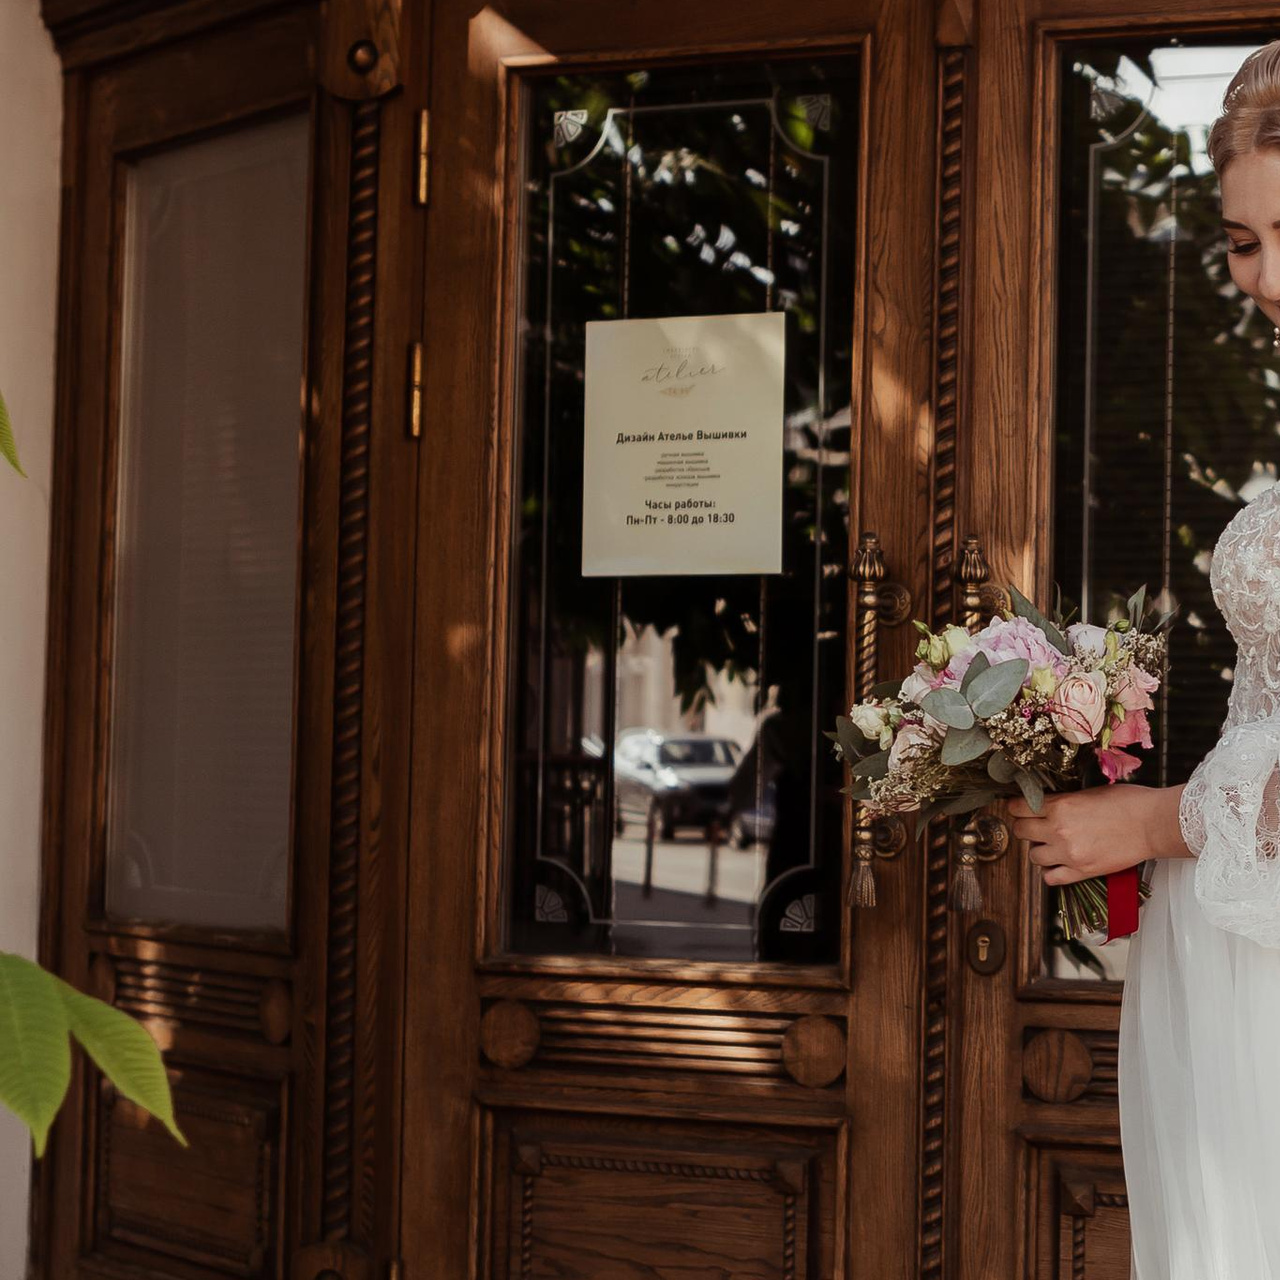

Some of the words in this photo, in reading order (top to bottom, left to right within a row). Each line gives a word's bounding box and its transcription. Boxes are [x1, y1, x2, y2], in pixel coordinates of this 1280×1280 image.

[641, 359, 726, 383] atelier
[616, 431, 655, 444] Дизайн
[658, 431, 694, 441] Ателье
[696, 430, 747, 440] Вышивки
[645, 500, 672, 510] Часы
[674, 498, 716, 511] работы:
[626, 514, 657, 525] Пн-Пт
[667, 514, 689, 524] 8:00
[691, 515, 704, 525] до
[708, 513, 735, 523] 18:30
